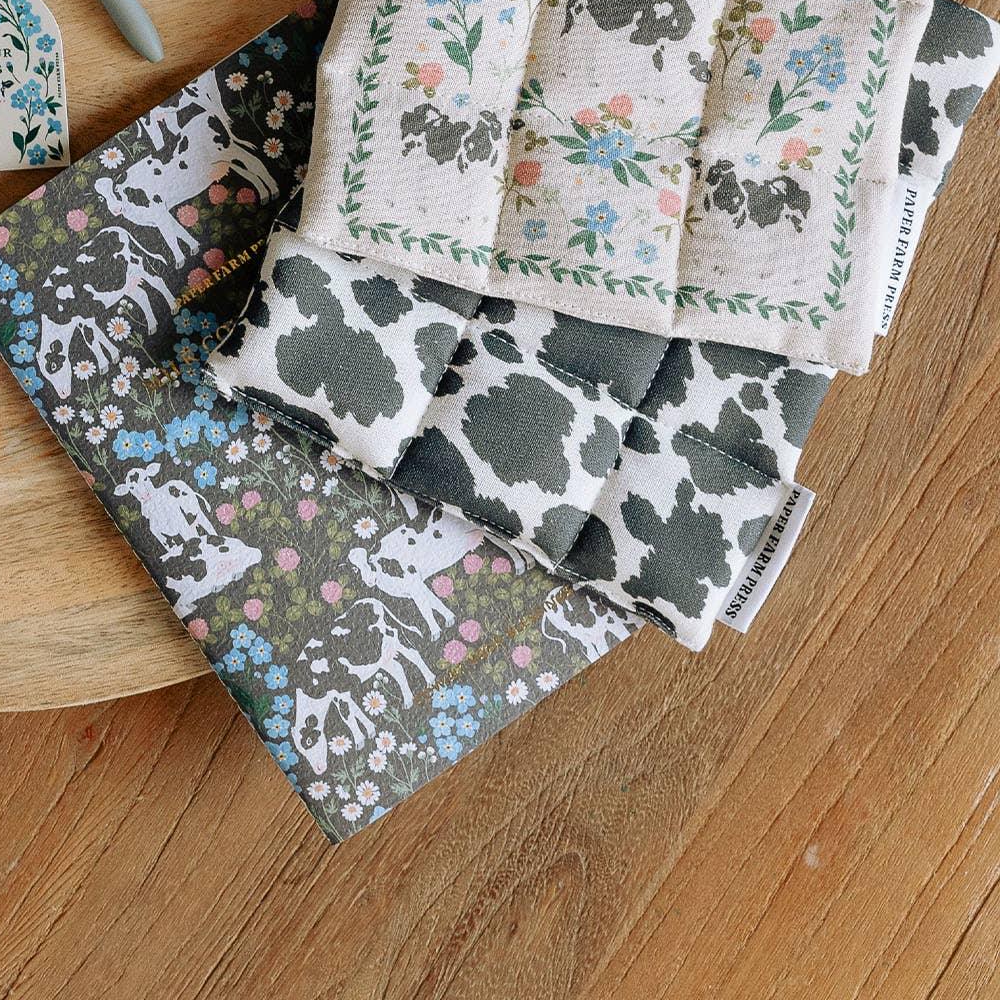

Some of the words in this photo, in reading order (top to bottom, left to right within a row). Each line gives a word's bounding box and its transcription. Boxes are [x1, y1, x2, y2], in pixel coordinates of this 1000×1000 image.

[899, 188, 918, 236] PAPER
[174, 277, 214, 309] PAPER
[212, 249, 252, 280] FARM
[889, 238, 910, 282] FARM
[881, 284, 898, 329] PRESS
[773, 488, 801, 533] PAPER
[750, 534, 780, 578] FARM
[724, 575, 758, 619] PRESS
